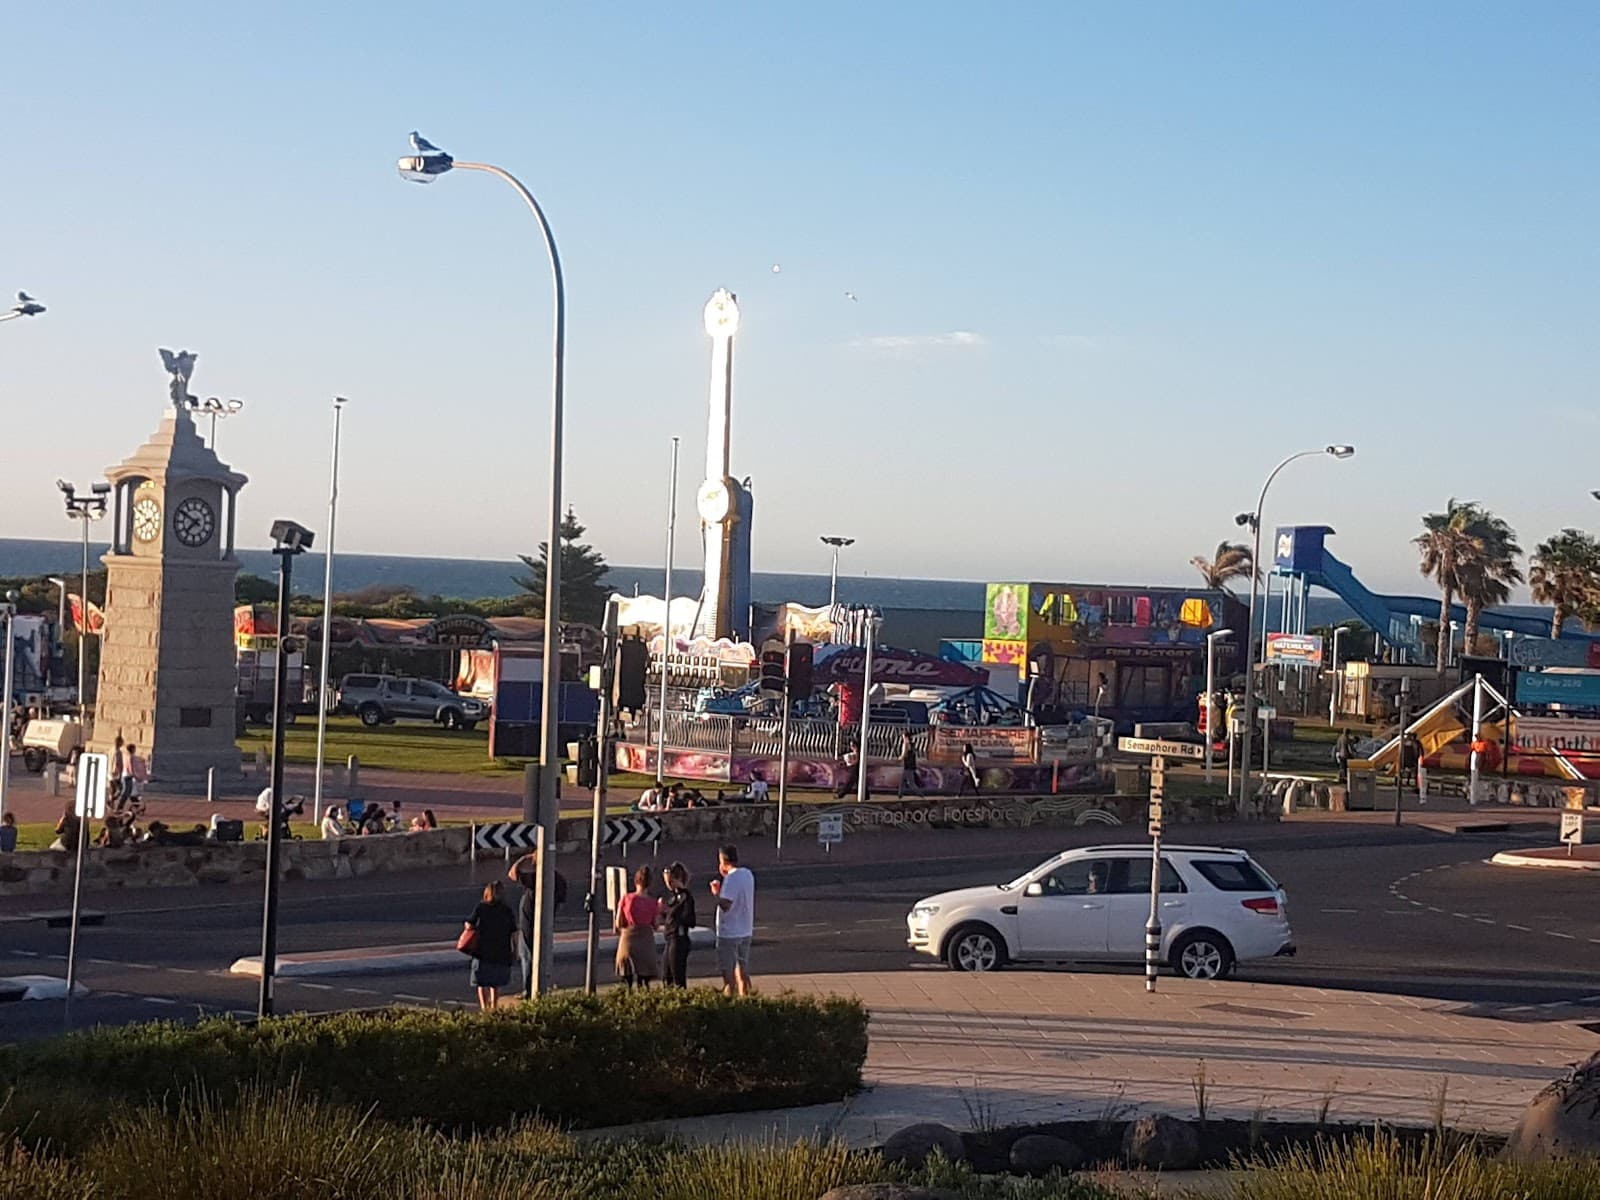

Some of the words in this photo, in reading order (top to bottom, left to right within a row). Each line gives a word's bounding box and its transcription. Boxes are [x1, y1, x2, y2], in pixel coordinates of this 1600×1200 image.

[938, 728, 1026, 739] SEMAPHORE
[1127, 739, 1178, 754] Semaphore
[1180, 744, 1194, 755] Rd
[853, 807, 938, 825] Semaphore
[944, 805, 1015, 823] Foreshore
